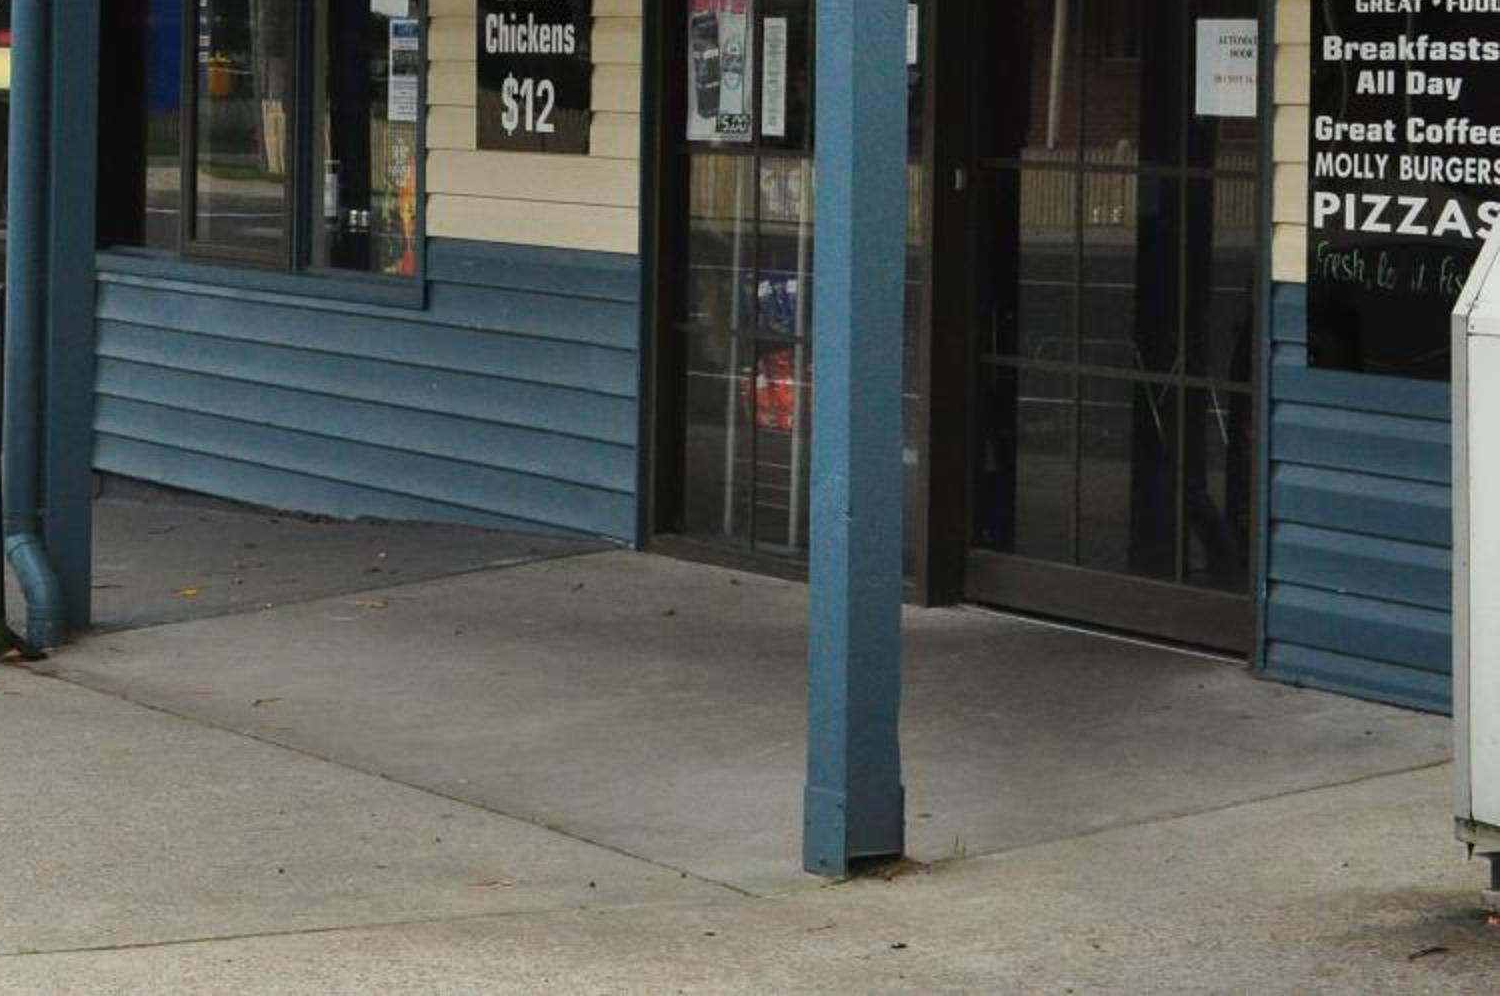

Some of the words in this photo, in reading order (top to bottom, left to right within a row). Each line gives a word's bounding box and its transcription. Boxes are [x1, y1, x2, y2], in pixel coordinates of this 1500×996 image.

[485, 12, 575, 54] Chickens
[1323, 35, 1500, 61] Breakfasts
[1356, 70, 1395, 95] All
[1406, 70, 1462, 101] Day
[501, 72, 555, 136] $12
[1315, 115, 1396, 143] Great
[1406, 117, 1500, 146] Coffee
[1315, 151, 1388, 180] MOLLY
